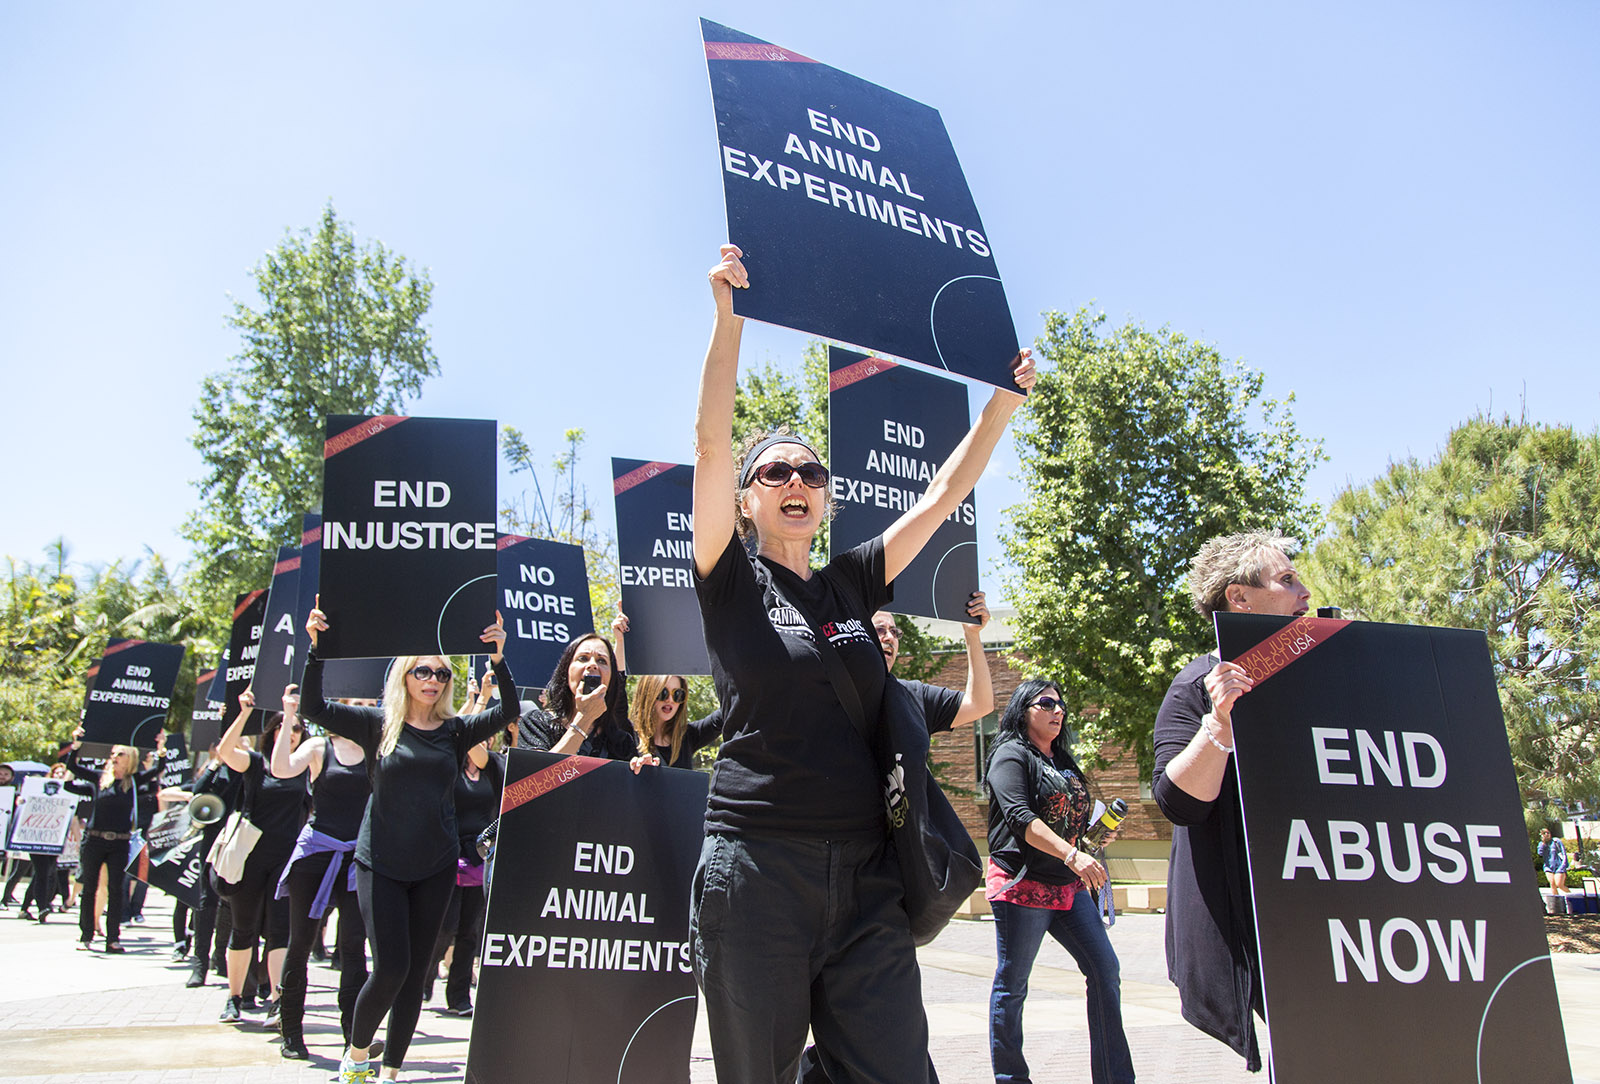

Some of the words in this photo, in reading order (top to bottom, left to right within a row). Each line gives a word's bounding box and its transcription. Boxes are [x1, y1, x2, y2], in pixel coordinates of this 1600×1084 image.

[765, 51, 790, 61] USA
[807, 107, 881, 153] END
[784, 132, 925, 201] ANIMAL
[722, 145, 990, 258] EXPERIMENTS
[864, 365, 879, 376] USA
[367, 423, 387, 436] USA
[883, 419, 926, 449] END
[645, 467, 661, 478] USA
[374, 480, 451, 508] END
[831, 475, 976, 526] EXPERIMTS
[323, 521, 497, 550] INJUSTICE
[667, 511, 694, 532] EN
[652, 538, 693, 560] ANI
[519, 563, 555, 586] NO
[620, 565, 695, 588] EXPERI
[504, 588, 576, 616] MORE
[250, 625, 263, 640] EN
[516, 618, 570, 643] LIES
[1269, 617, 1316, 655] JUSTICE
[126, 664, 151, 678] END
[1246, 647, 1290, 683] ROJECT
[1288, 633, 1317, 656] USA
[89, 689, 170, 709] EXPERIMENTS
[111, 677, 156, 693] ANIMAL
[164, 758, 192, 775] TURE
[1311, 727, 1448, 788] END
[503, 777, 542, 800] ANIMAL
[543, 756, 583, 782] JUSTICE
[511, 776, 557, 806] PROJECT
[557, 767, 580, 783] USA
[22, 814, 65, 829] KILLS
[574, 842, 635, 876] END
[1281, 819, 1511, 884] ABUSE
[177, 852, 201, 889] MO
[540, 887, 655, 924] ANIMAL
[483, 933, 694, 973] EXPERIMENTS
[1327, 917, 1487, 984] NOW
